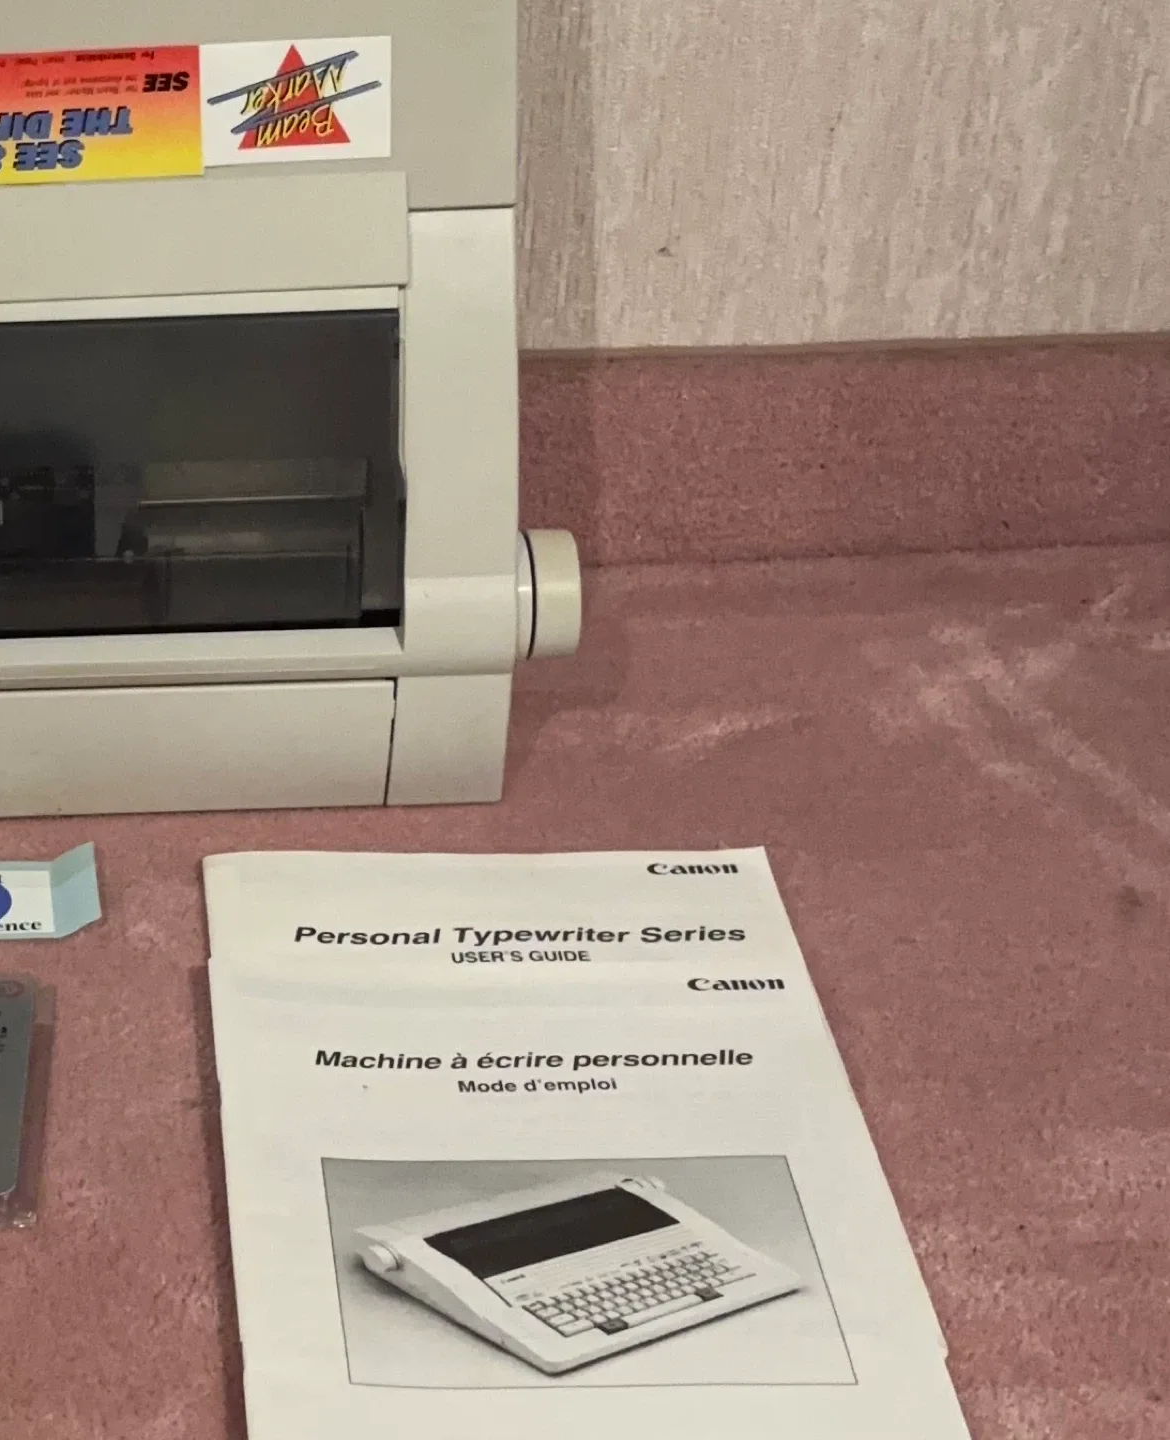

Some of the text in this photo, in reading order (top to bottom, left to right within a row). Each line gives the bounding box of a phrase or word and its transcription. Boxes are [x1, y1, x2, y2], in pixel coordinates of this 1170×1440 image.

[143, 71, 190, 93] SEE
[240, 59, 351, 115] Marker
[60, 106, 133, 138] THE
[255, 105, 335, 148] Beam
[14, 139, 85, 171] SEE
[645, 863, 739, 875] Canon
[294, 926, 746, 947] Personal Typewriter Series
[451, 950, 591, 964] USER'S GUIDE
[686, 977, 786, 991] Canon
[315, 1049, 753, 1071] Machine à écrire personnelle
[457, 1078, 617, 1093] Mode d'emploi
